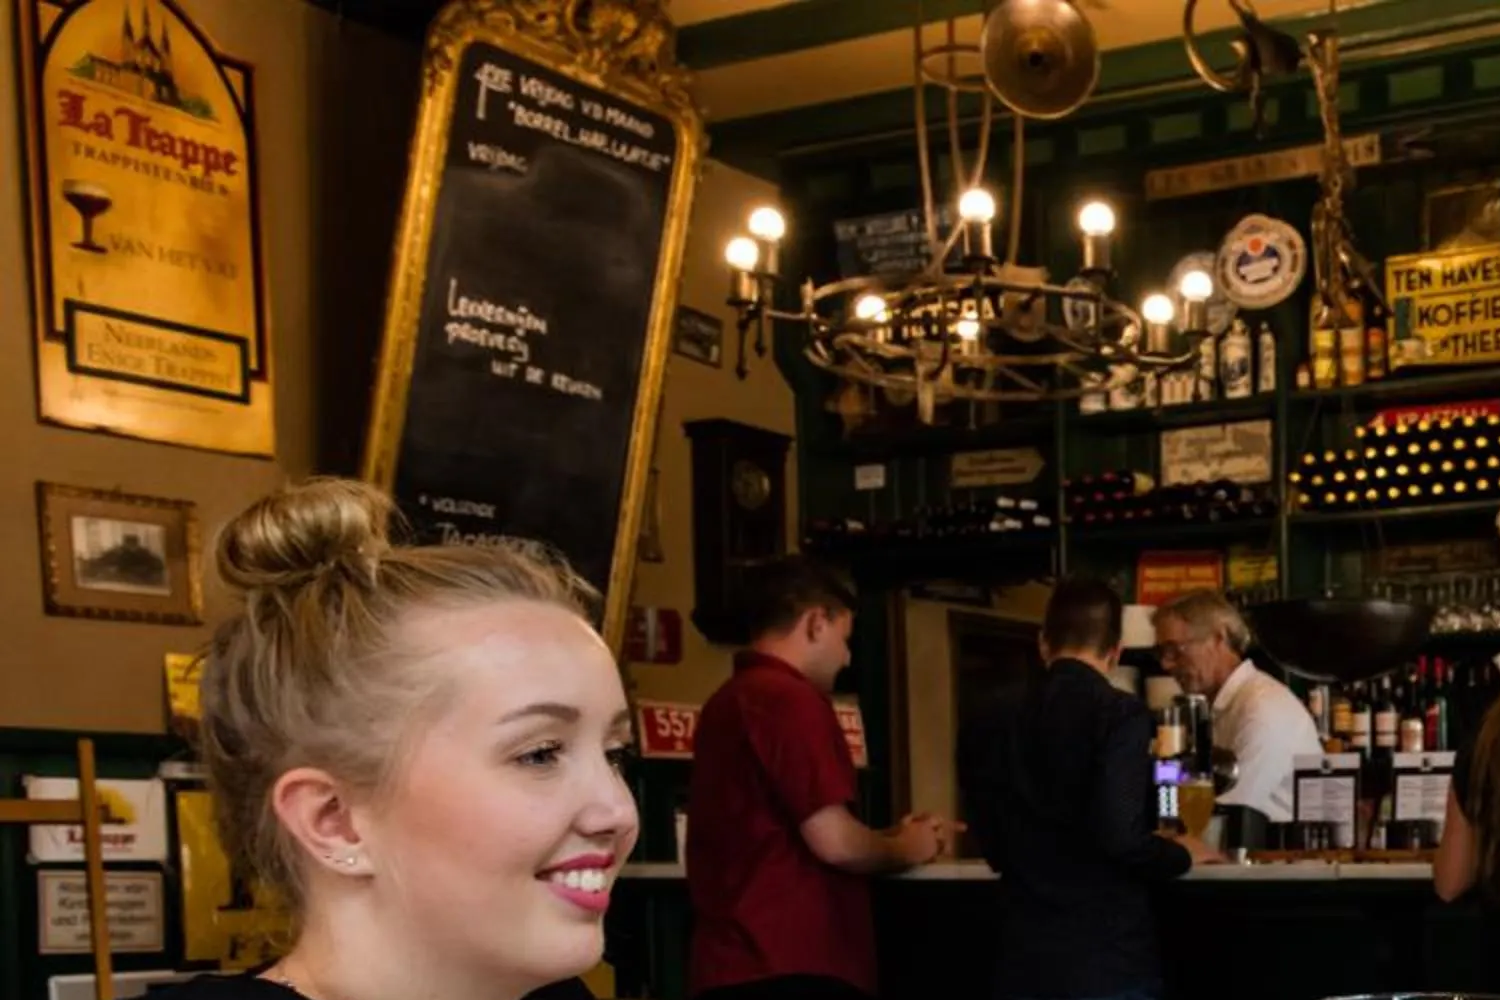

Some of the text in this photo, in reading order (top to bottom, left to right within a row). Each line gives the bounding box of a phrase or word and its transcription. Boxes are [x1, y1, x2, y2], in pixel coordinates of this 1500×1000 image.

[57, 90, 237, 176] La Trappe
[1393, 266, 1432, 292] TEN
